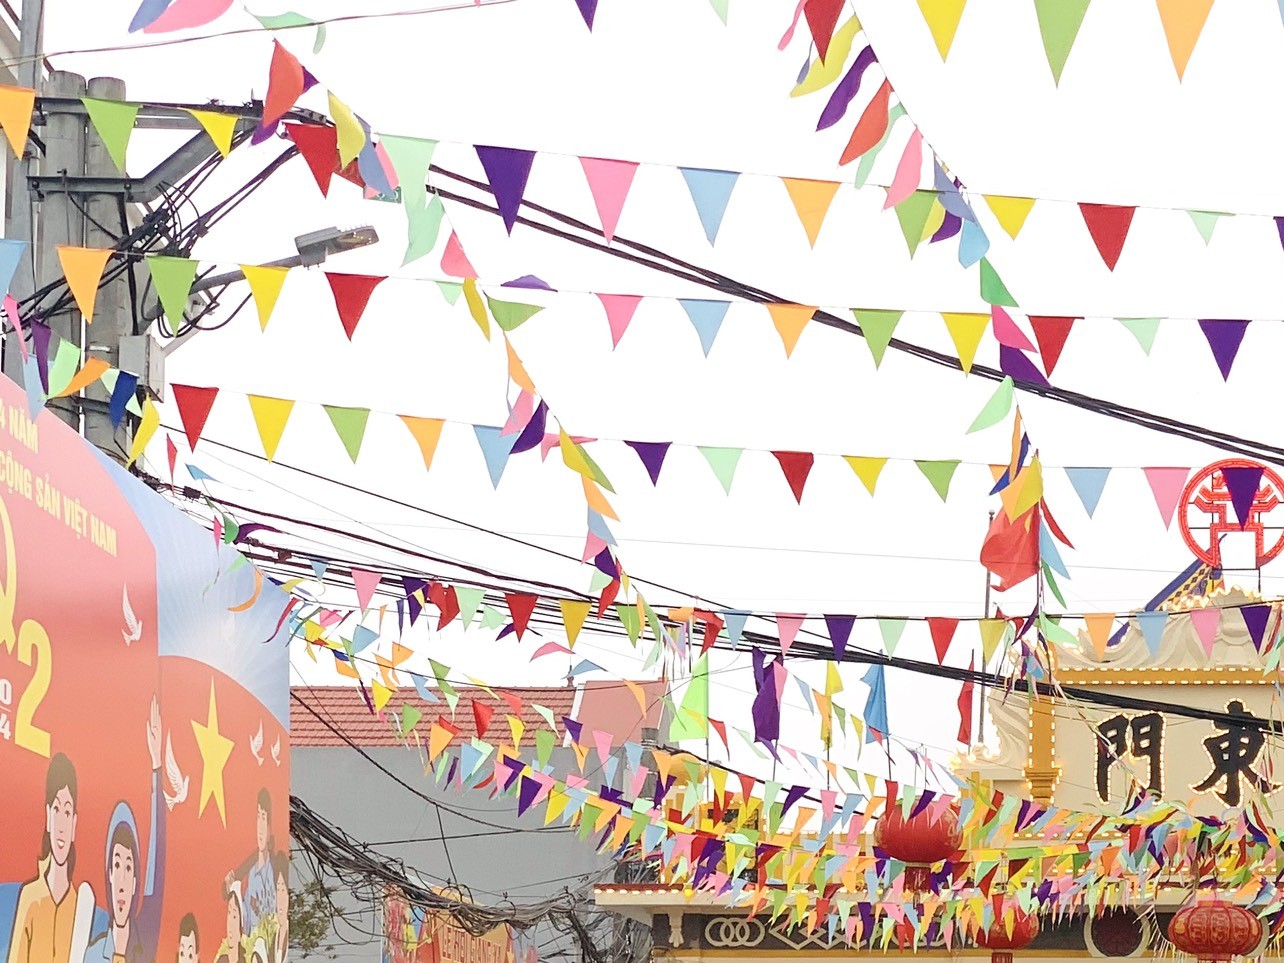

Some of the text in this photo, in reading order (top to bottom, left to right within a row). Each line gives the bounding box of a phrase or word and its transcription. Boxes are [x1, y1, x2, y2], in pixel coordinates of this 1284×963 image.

[35, 472, 61, 520] SẢN
[63, 496, 88, 540] VIỆT
[90, 514, 118, 558] NAM
